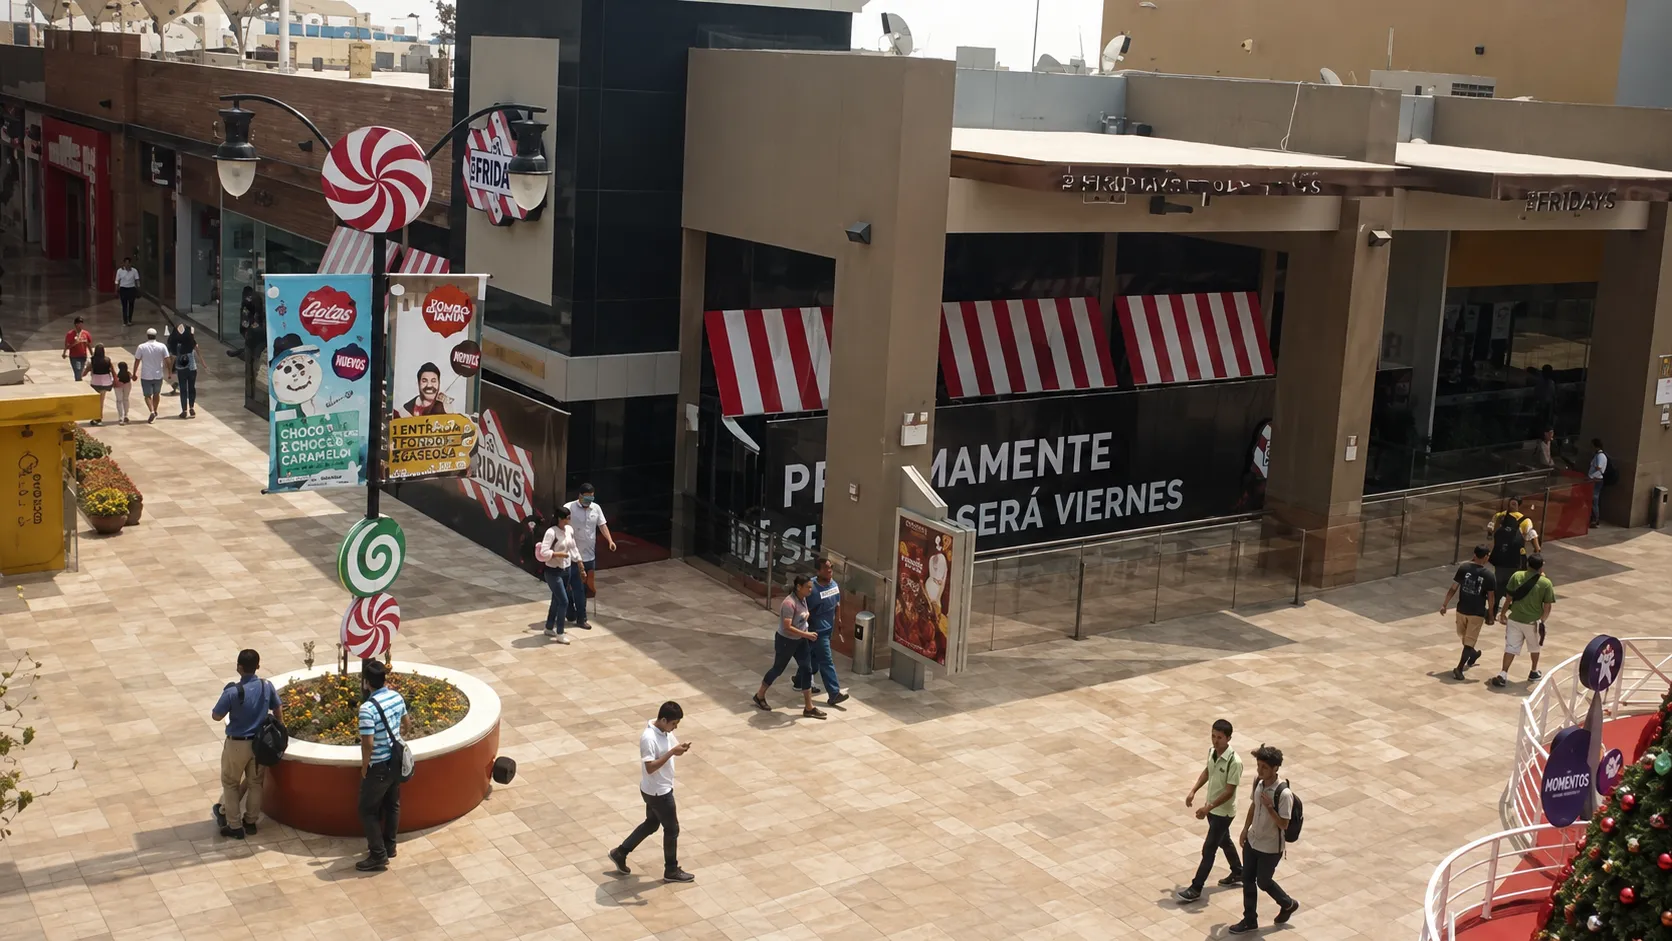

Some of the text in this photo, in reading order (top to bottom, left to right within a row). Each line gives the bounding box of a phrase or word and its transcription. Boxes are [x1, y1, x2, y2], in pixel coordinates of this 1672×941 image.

[1535, 190, 1617, 212] FRIDAYS
[280, 425, 324, 439] CHOCO
[956, 486, 1044, 537] SERÁ
[1054, 478, 1184, 525] VIERNES
[1544, 772, 1590, 793] MOMENTOS
